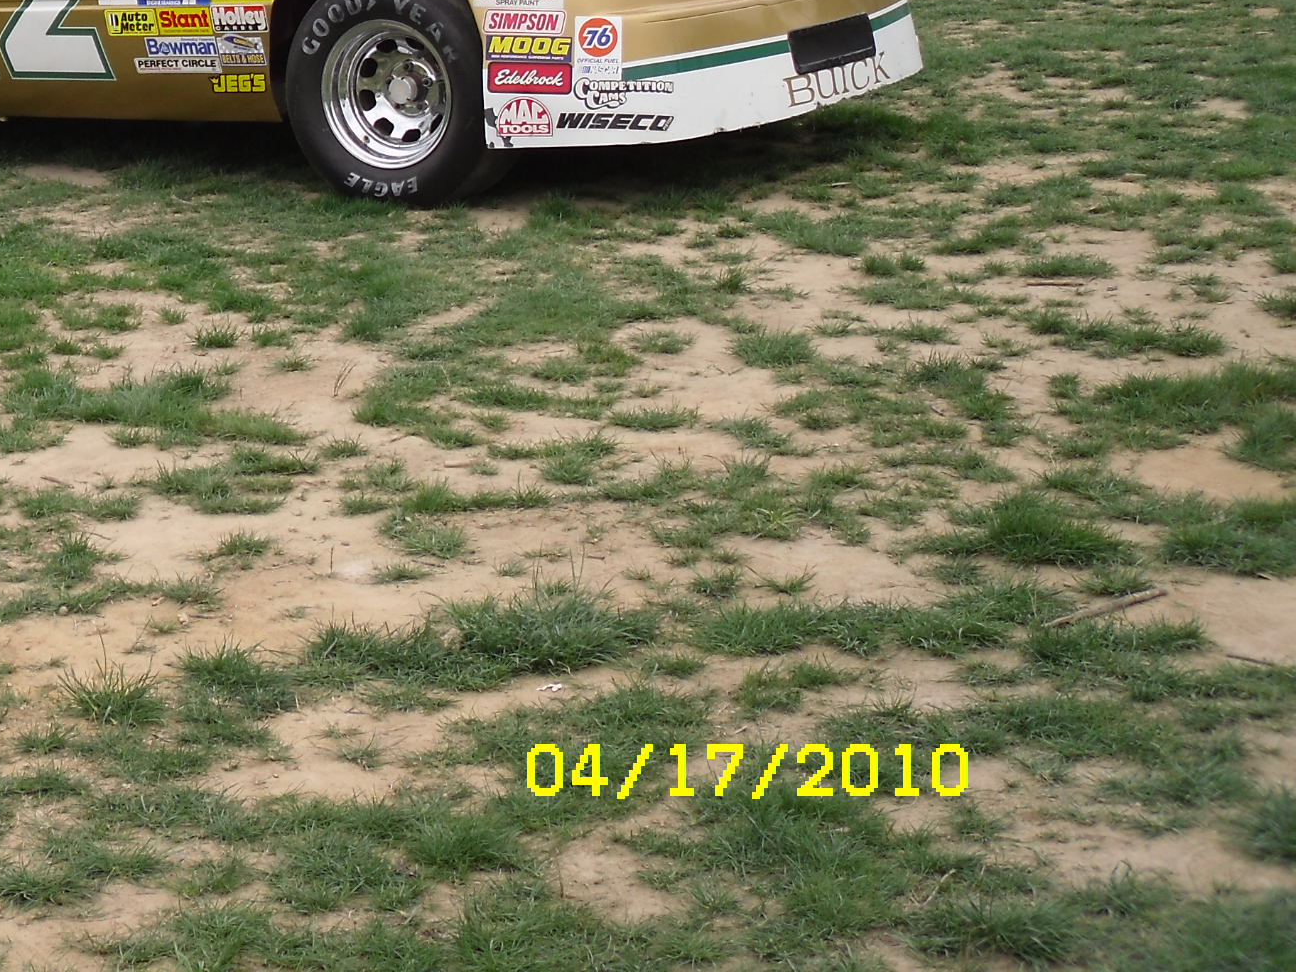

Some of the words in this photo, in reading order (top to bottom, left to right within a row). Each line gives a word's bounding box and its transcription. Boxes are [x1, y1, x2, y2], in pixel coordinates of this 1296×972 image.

[519, 0, 540, 7] PAINT
[121, 12, 148, 21] Auto
[159, 9, 210, 28] Stant
[212, 6, 266, 30] Holley
[489, 12, 559, 31] SIMPSON
[121, 21, 154, 32] Meter
[584, 23, 612, 48] 76
[146, 38, 217, 55] Bowman
[488, 36, 571, 55] MOOG
[138, 59, 179, 68] PERFECT
[181, 59, 216, 68] CIRCLE
[213, 74, 266, 93] JEG'S
[494, 69, 564, 86] Edelbrock
[783, 51, 891, 108] BUICK
[573, 78, 674, 100] COMPETITION
[586, 91, 628, 110] CAMS
[500, 99, 547, 125] MAC
[500, 124, 550, 134] TOOLS
[556, 113, 674, 131] WISECO
[343, 171, 419, 198] EAGLE
